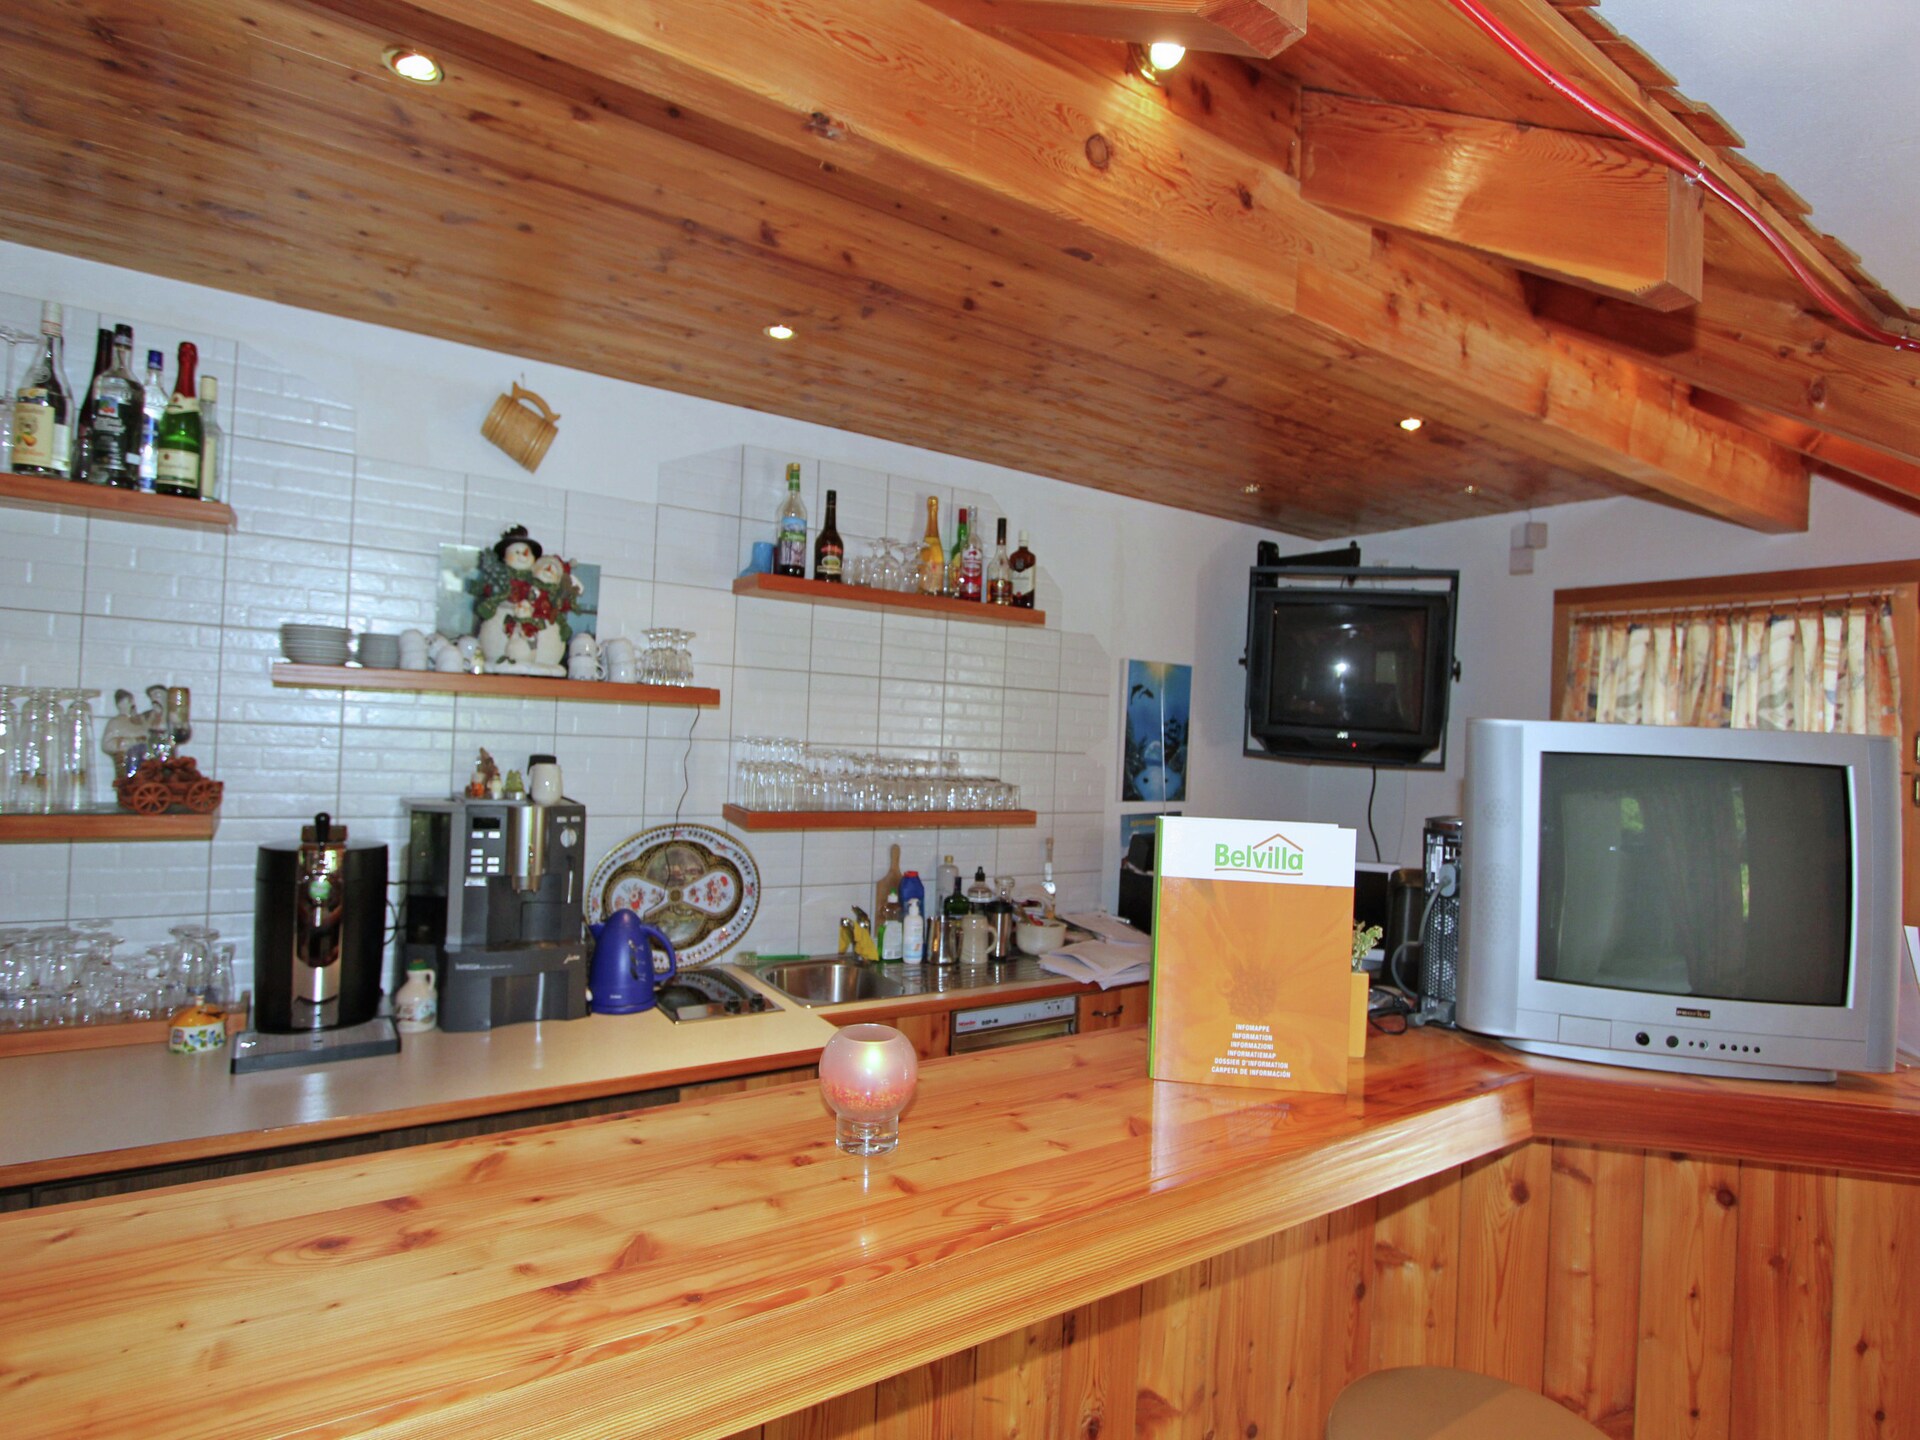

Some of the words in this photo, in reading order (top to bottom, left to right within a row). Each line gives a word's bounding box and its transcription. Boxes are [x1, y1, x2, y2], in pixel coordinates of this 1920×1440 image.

[1214, 843, 1304, 870] Belvilla
[1235, 1023, 1270, 1033] INFOMAPPE
[1231, 1032, 1273, 1041] INFORMATION
[1230, 1041, 1274, 1050] INFORMAZIONI
[1227, 1050, 1276, 1059] INFORMATIEMAP
[1214, 1057, 1240, 1066] DOSSIER
[1211, 1066, 1238, 1075] CARPETA
[1249, 1068, 1291, 1078] INFORMACIÓN
